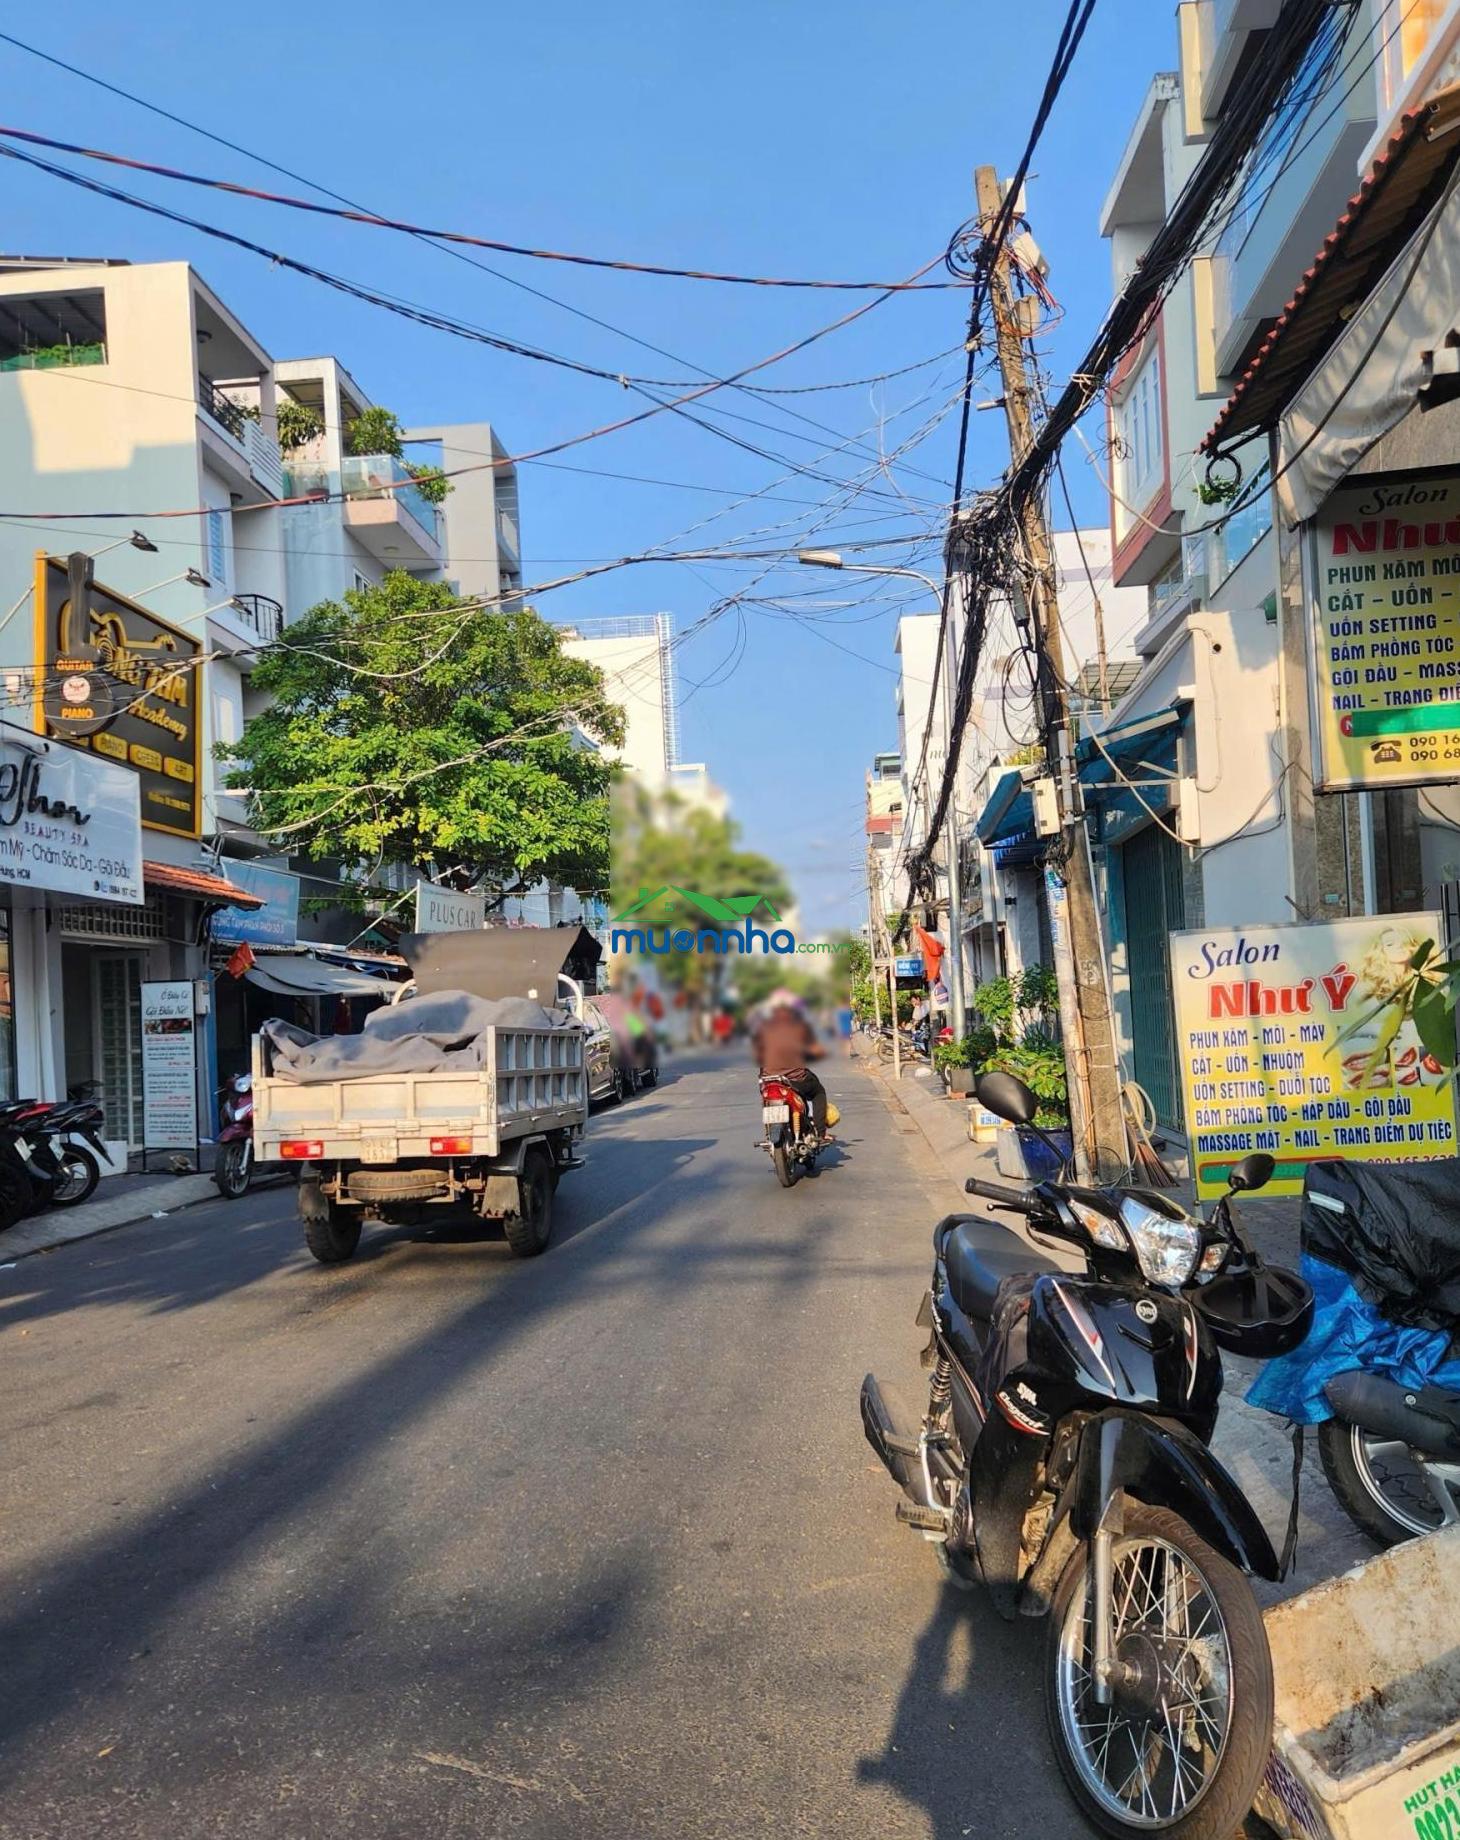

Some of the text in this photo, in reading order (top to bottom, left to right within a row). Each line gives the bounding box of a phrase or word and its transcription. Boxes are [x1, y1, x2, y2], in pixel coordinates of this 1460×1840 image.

[1359, 484, 1449, 515] Salon
[1328, 564, 1376, 585] PHUN
[1383, 558, 1425, 580] XĂM
[1328, 588, 1365, 612] CẮT
[1392, 582, 1433, 606] UỐN
[1330, 615, 1363, 637] UỐN
[1370, 614, 1437, 634] SETTING
[1331, 635, 1454, 661] BẤM PHỒNG TÓC
[56, 659, 95, 671] GUITAR
[1332, 667, 1358, 688] GỘI
[1365, 661, 1397, 683] ĐẦU
[1333, 694, 1366, 711] NAIL
[1384, 688, 1433, 706] TRANG
[61, 706, 94, 720] PIANO
[1410, 736, 1437, 748] 090
[1411, 750, 1438, 761] 090
[24, 821, 90, 847] BEAUTY SPA
[80, 854, 93, 872] Da
[430, 900, 477, 929] PLUS CAR
[1188, 938, 1280, 980] Salon
[1209, 962, 1358, 1019] Như Ý
[1190, 1031, 1219, 1049] PHUN
[1226, 1050, 1249, 1073] UỐN
[1194, 1078, 1216, 1100] UỐN
[1220, 1081, 1265, 1099] SETTING
[1195, 1104, 1221, 1127] BẤM
[1225, 1104, 1263, 1125] PHỒNG
[1266, 1102, 1288, 1123] TÓC
[1301, 1097, 1324, 1121] HẤP
[1327, 1096, 1350, 1119] DẦU
[1364, 1096, 1384, 1120] GỘI
[1388, 1092, 1411, 1116] ĐẦU
[1197, 1133, 1253, 1152] MASSAGE
[1256, 1129, 1280, 1152] MẶT
[1294, 1129, 1321, 1148] NAIL
[1333, 1126, 1371, 1145] TRANG
[1374, 1118, 1405, 1143] ĐIỂM
[1408, 1122, 1424, 1144] DỰ
[1427, 1119, 1452, 1143] TIỆC
[1403, 1781, 1438, 1814] HUT
